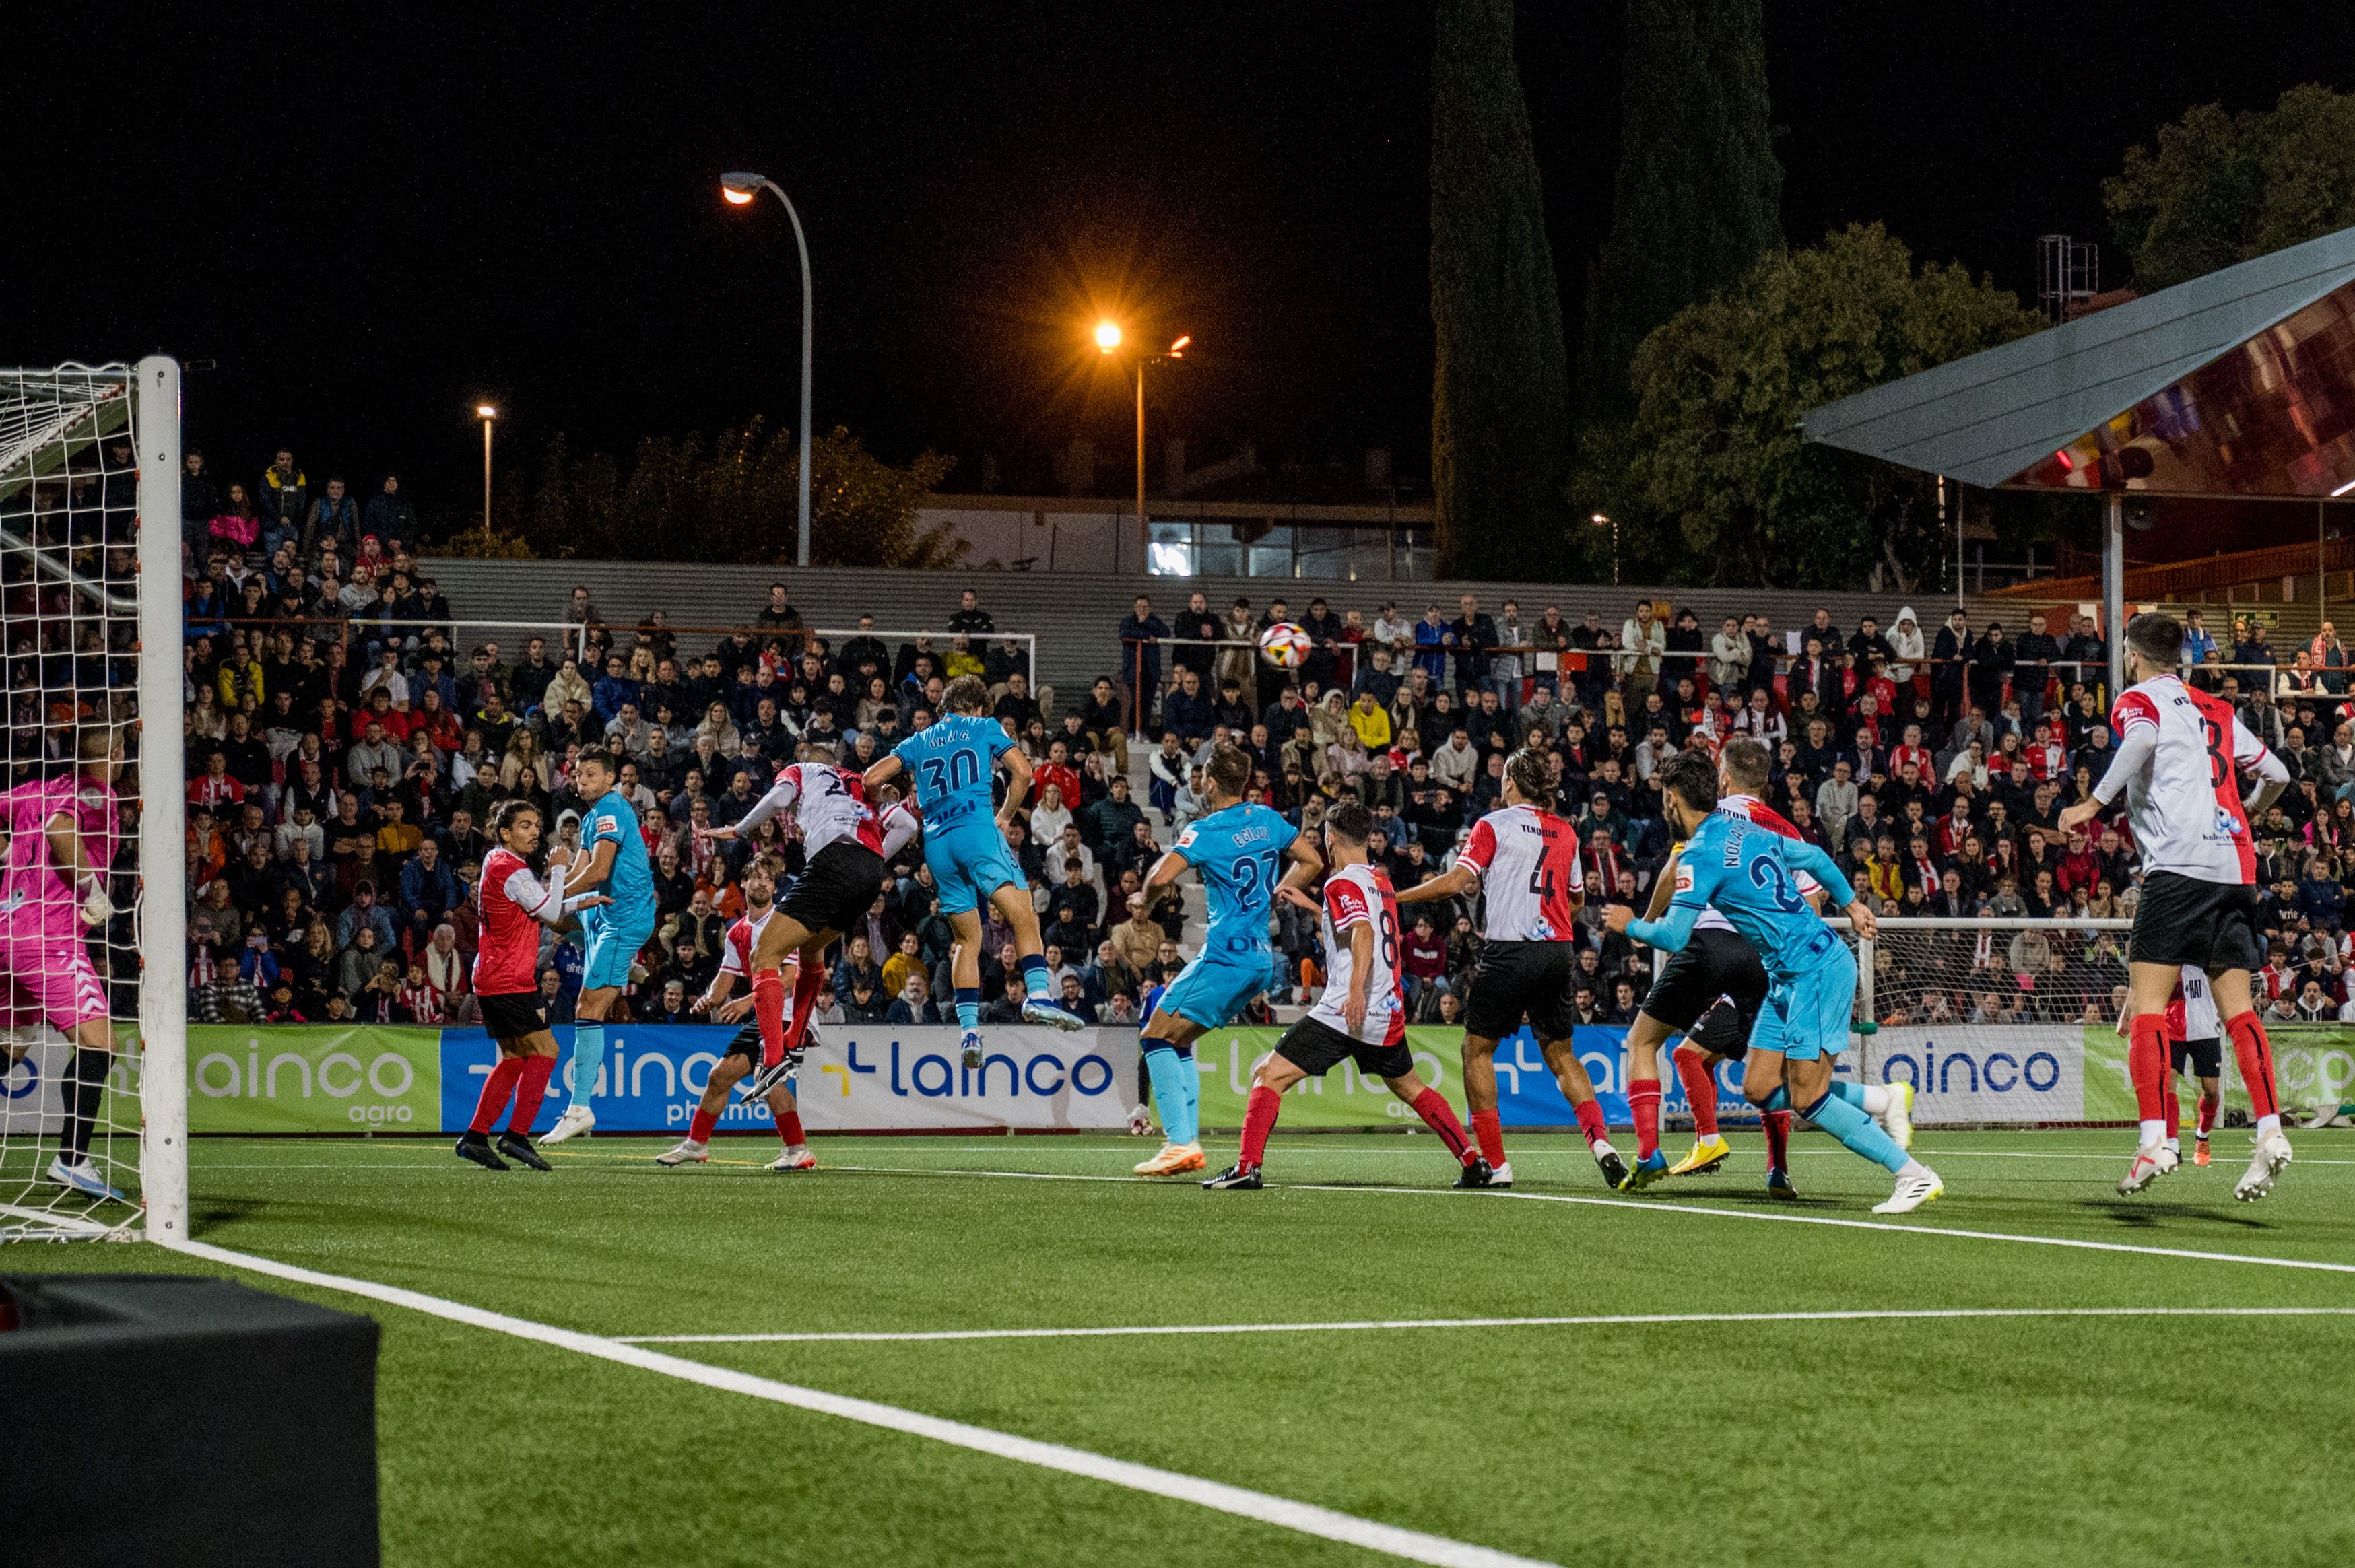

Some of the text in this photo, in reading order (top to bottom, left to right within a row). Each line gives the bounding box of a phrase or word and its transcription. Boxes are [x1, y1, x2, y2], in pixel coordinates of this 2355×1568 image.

[921, 747, 980, 797] 30
[2199, 717, 2228, 788] 3
[1521, 824, 1558, 839] TENORIO
[1230, 848, 1280, 914] 27
[1529, 845, 1556, 906] 4
[1379, 909, 1399, 969] 8
[186, 1039, 413, 1098] ainco
[545, 1039, 753, 1097] ainc
[891, 1041, 1113, 1097] lainco
[1882, 1040, 2060, 1093] ainco
[347, 1105, 413, 1126] agro
[667, 1099, 770, 1126] phma
